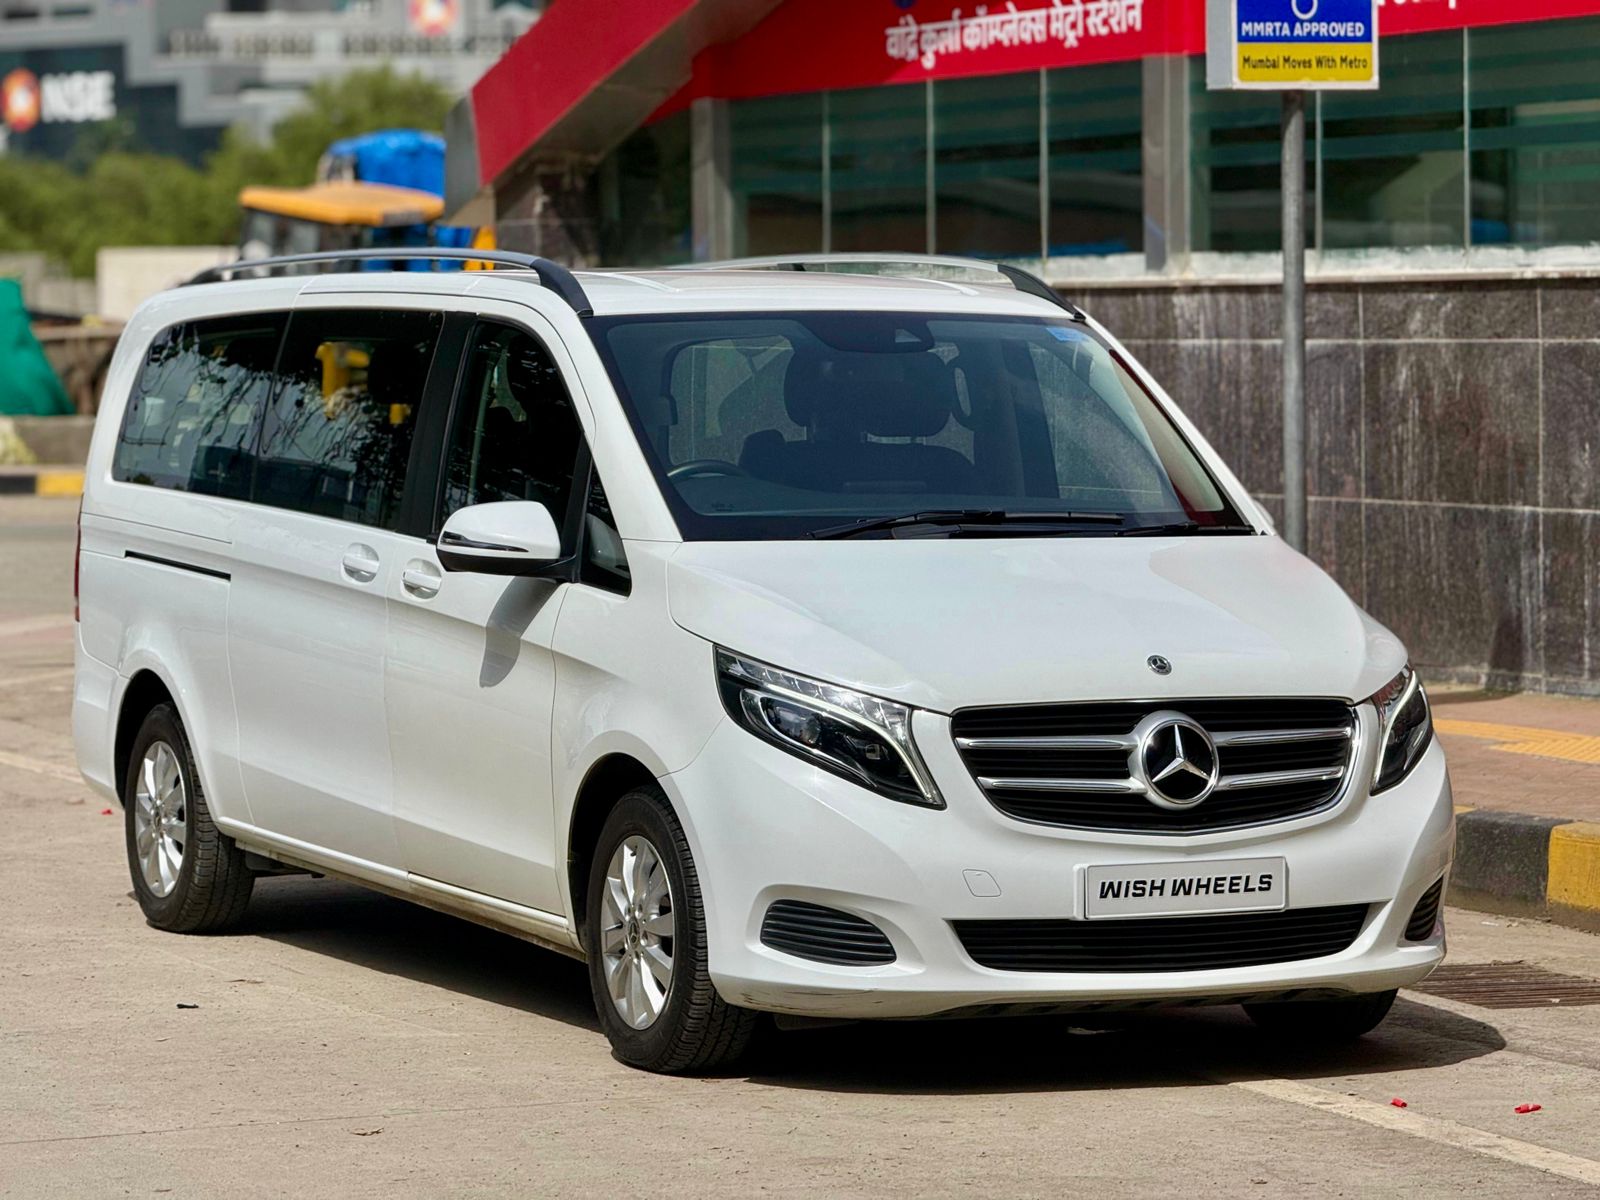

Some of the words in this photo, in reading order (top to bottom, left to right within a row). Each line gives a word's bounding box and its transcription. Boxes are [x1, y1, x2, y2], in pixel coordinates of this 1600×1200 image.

[920, 8, 961, 70] कुर्ला
[1085, 0, 1143, 37] स्टशन
[1241, 21, 1291, 37] MMRTA
[1293, 21, 1365, 37] APPROVED
[1242, 55, 1280, 69] Mumbai
[1282, 55, 1313, 69] Moves
[1314, 55, 1337, 69] With
[1339, 55, 1369, 69] Metro
[41, 70, 116, 122] NSE
[1099, 879, 1166, 899] WISH
[1171, 873, 1273, 897] WHEELS
